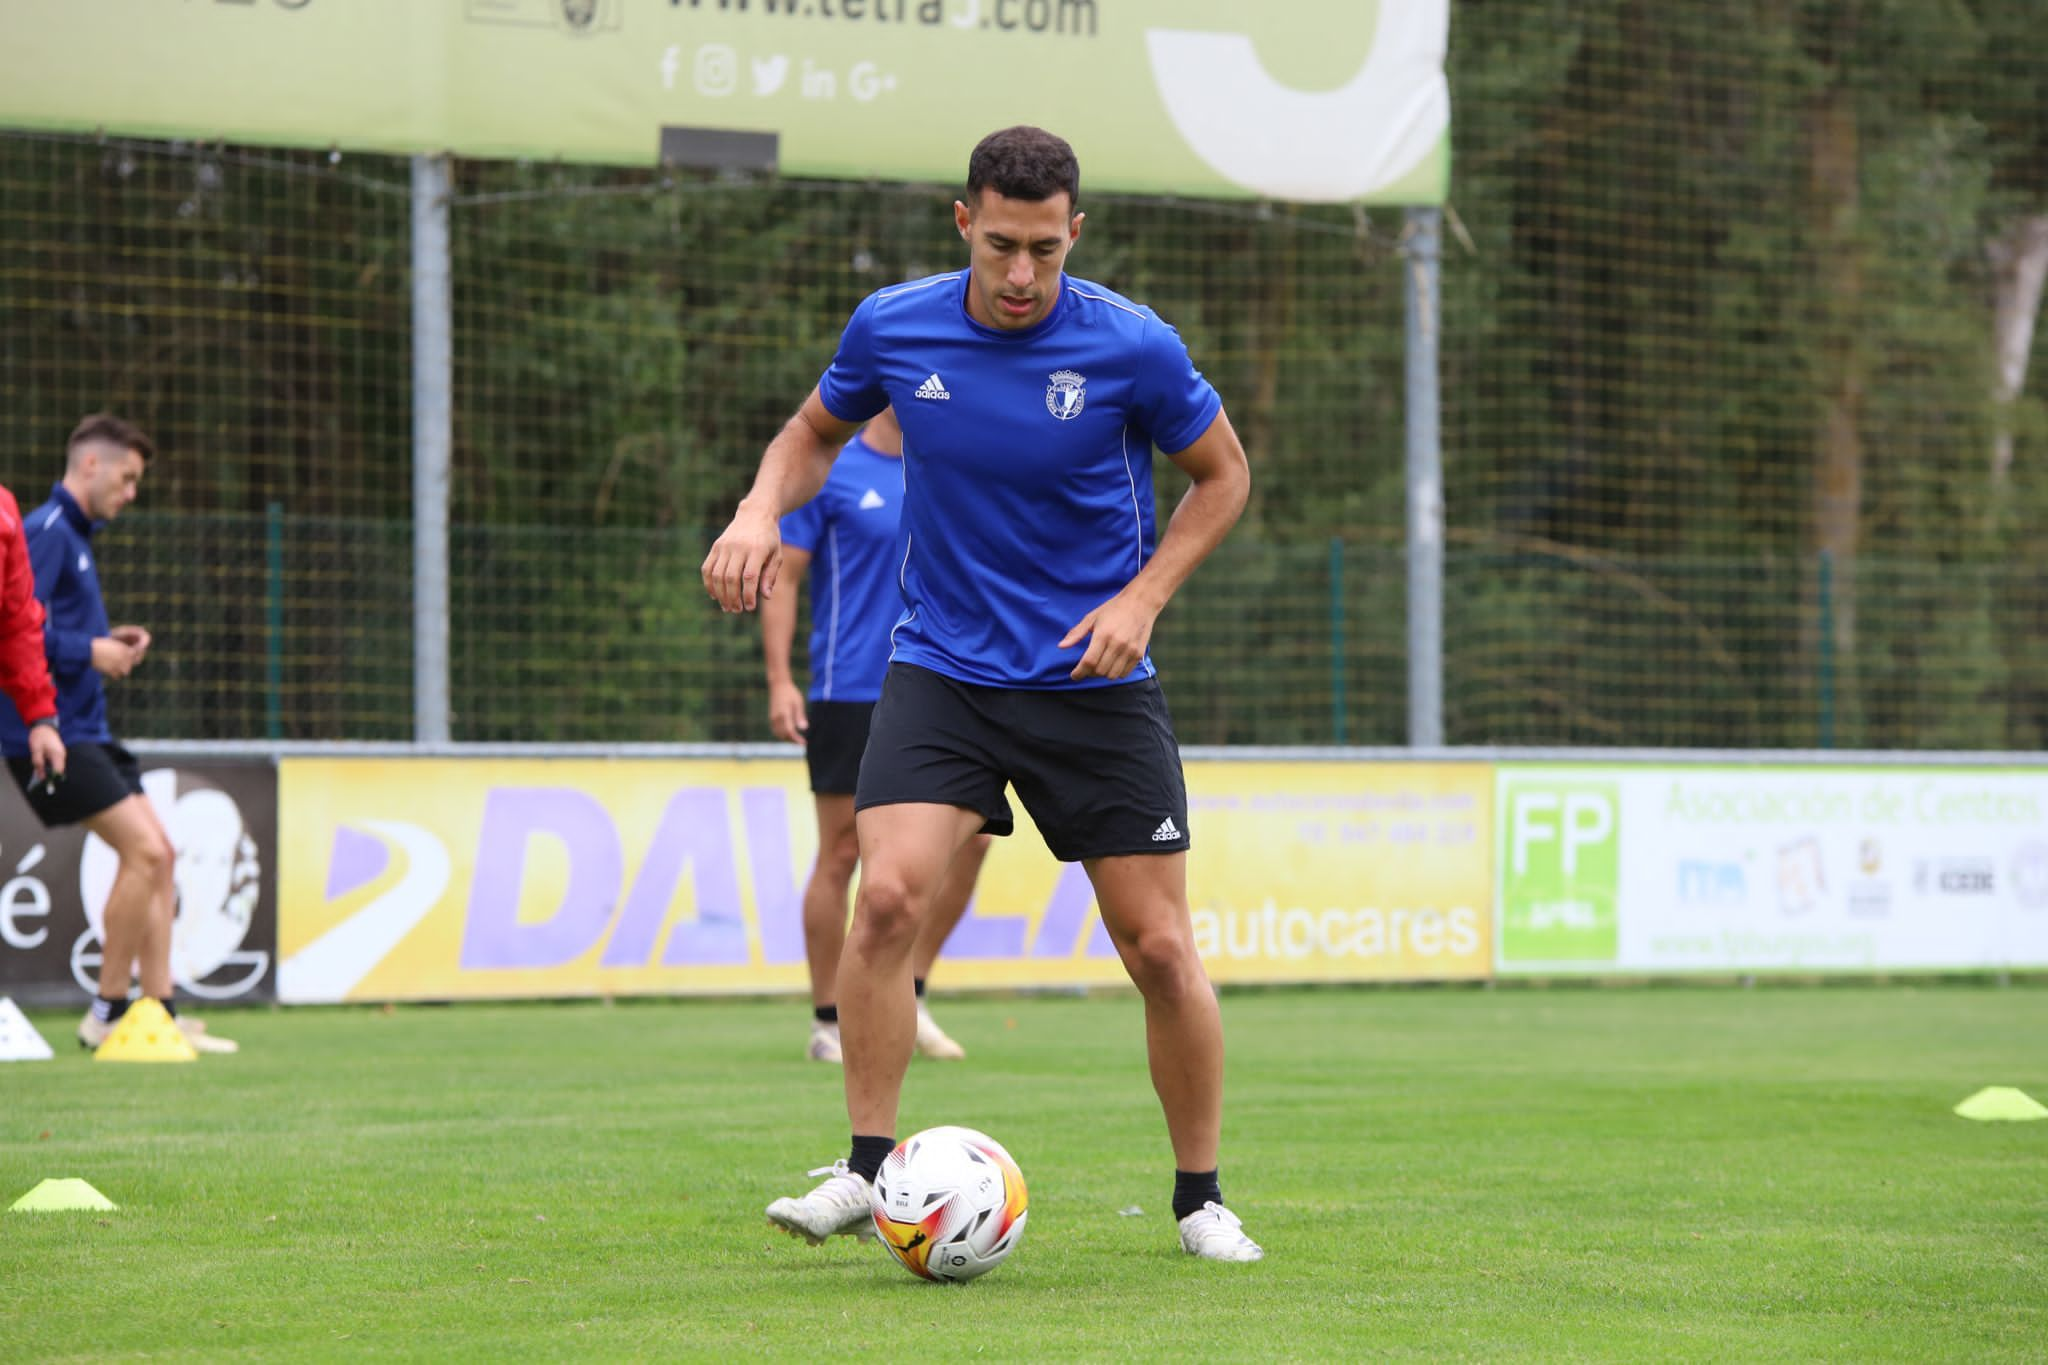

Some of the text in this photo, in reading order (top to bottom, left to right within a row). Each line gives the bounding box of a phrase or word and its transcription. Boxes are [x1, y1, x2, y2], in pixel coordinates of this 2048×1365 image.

[914, 389, 951, 400] adidas
[1513, 793, 1612, 876] FP
[1193, 897, 1479, 961] autocares
